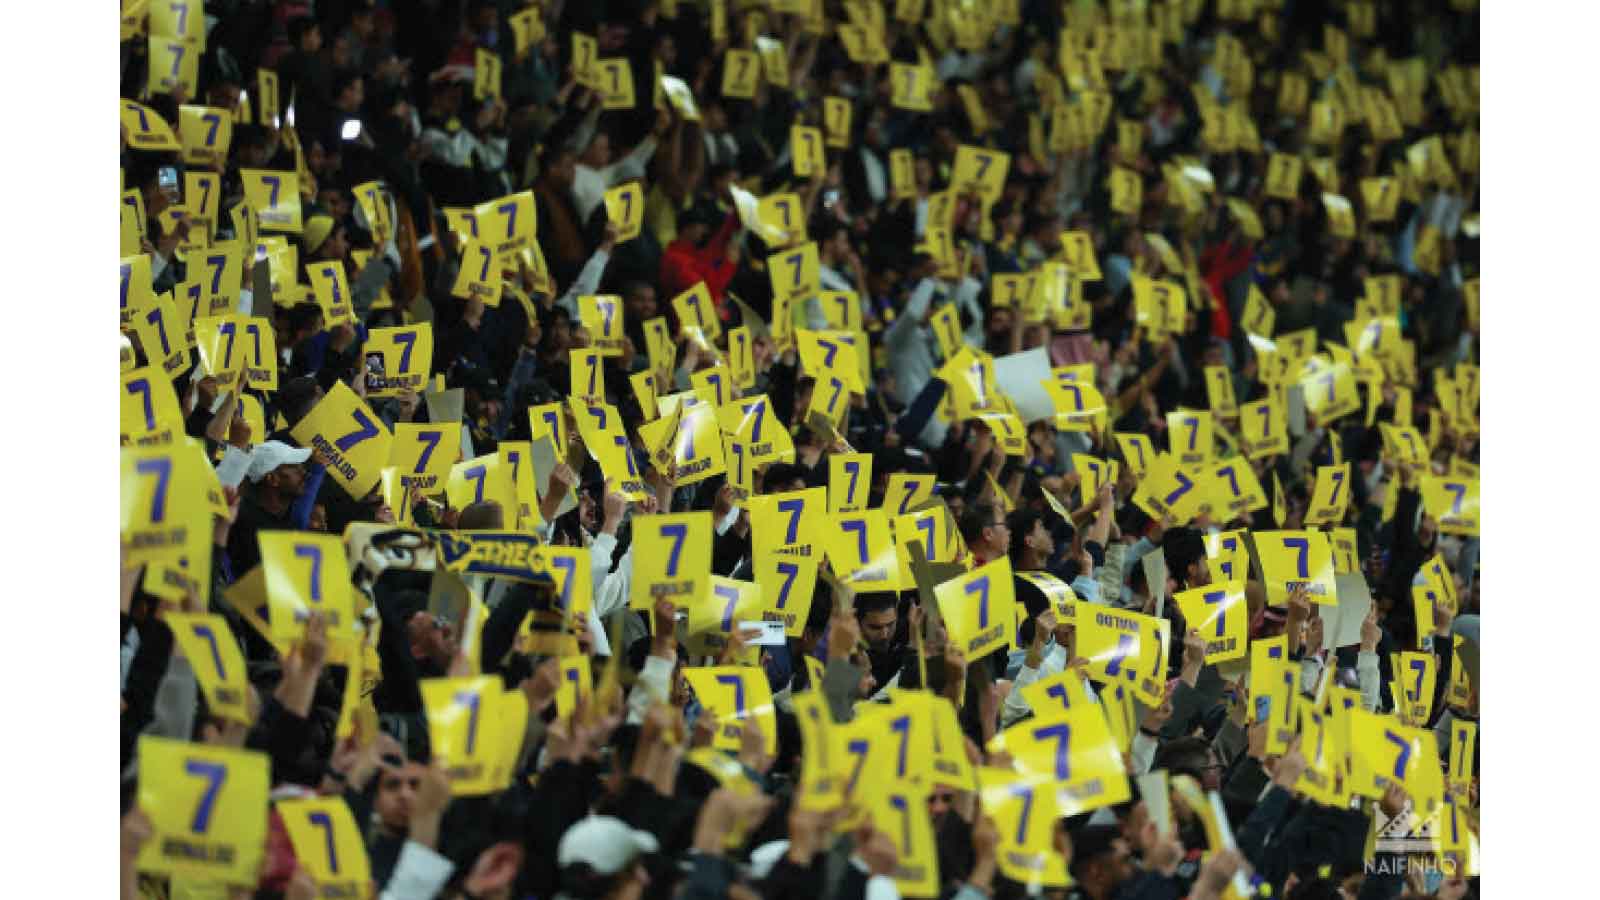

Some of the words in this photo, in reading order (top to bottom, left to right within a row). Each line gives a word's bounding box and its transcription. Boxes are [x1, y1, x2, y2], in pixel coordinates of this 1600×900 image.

[127, 104, 149, 132] 7
[203, 115, 221, 145] 7
[262, 176, 280, 208] 7
[620, 191, 631, 223] 7
[499, 202, 517, 239] 7
[208, 256, 225, 292] 7
[480, 247, 491, 281] 7
[787, 254, 803, 286] 7
[899, 55, 919, 481] 7
[188, 284, 201, 326] 7
[322, 267, 341, 303] 7
[1028, 278, 1036, 298] 7
[597, 302, 614, 337] 7
[688, 294, 703, 322] 7
[147, 309, 170, 354] 7
[219, 322, 235, 367] 7
[247, 325, 261, 366] 7
[394, 332, 417, 374] 7
[817, 340, 838, 368] 7
[586, 355, 598, 394] 7
[707, 375, 722, 407] 7
[828, 377, 842, 413] 7
[127, 378, 154, 431] 7
[1061, 385, 1084, 411] 7
[336, 408, 379, 453] 7
[543, 411, 560, 453] 7
[742, 401, 765, 442] 7
[1183, 417, 1200, 451] 7
[1257, 405, 1271, 437] 7
[417, 432, 440, 473] 7
[614, 435, 637, 476] 7
[732, 442, 744, 484] 7
[136, 458, 171, 522] 7
[465, 465, 486, 505] 7
[845, 462, 859, 503] 7
[1165, 472, 1192, 505] 7
[1216, 466, 1240, 497] 7
[1331, 472, 1344, 505] 7
[1444, 483, 1465, 513] 7
[778, 500, 805, 544] 7
[840, 520, 869, 564] 7
[916, 516, 936, 560] 7
[660, 523, 687, 576] 7
[1284, 537, 1310, 578] 7
[294, 545, 321, 601] 7
[553, 556, 575, 608] 7
[776, 562, 799, 609] 7
[714, 585, 739, 631] 7
[965, 577, 990, 628] 7
[1204, 591, 1227, 637] 7
[192, 625, 227, 679] 7
[716, 674, 744, 719] 7
[1411, 659, 1425, 700] 7
[848, 741, 869, 792] 7
[892, 716, 909, 777] 7
[1034, 723, 1069, 781] 7
[1384, 730, 1411, 778] 7
[185, 760, 226, 833] 7
[1010, 786, 1032, 845] 7
[1445, 793, 1458, 843] 7
[309, 812, 338, 874] 7
